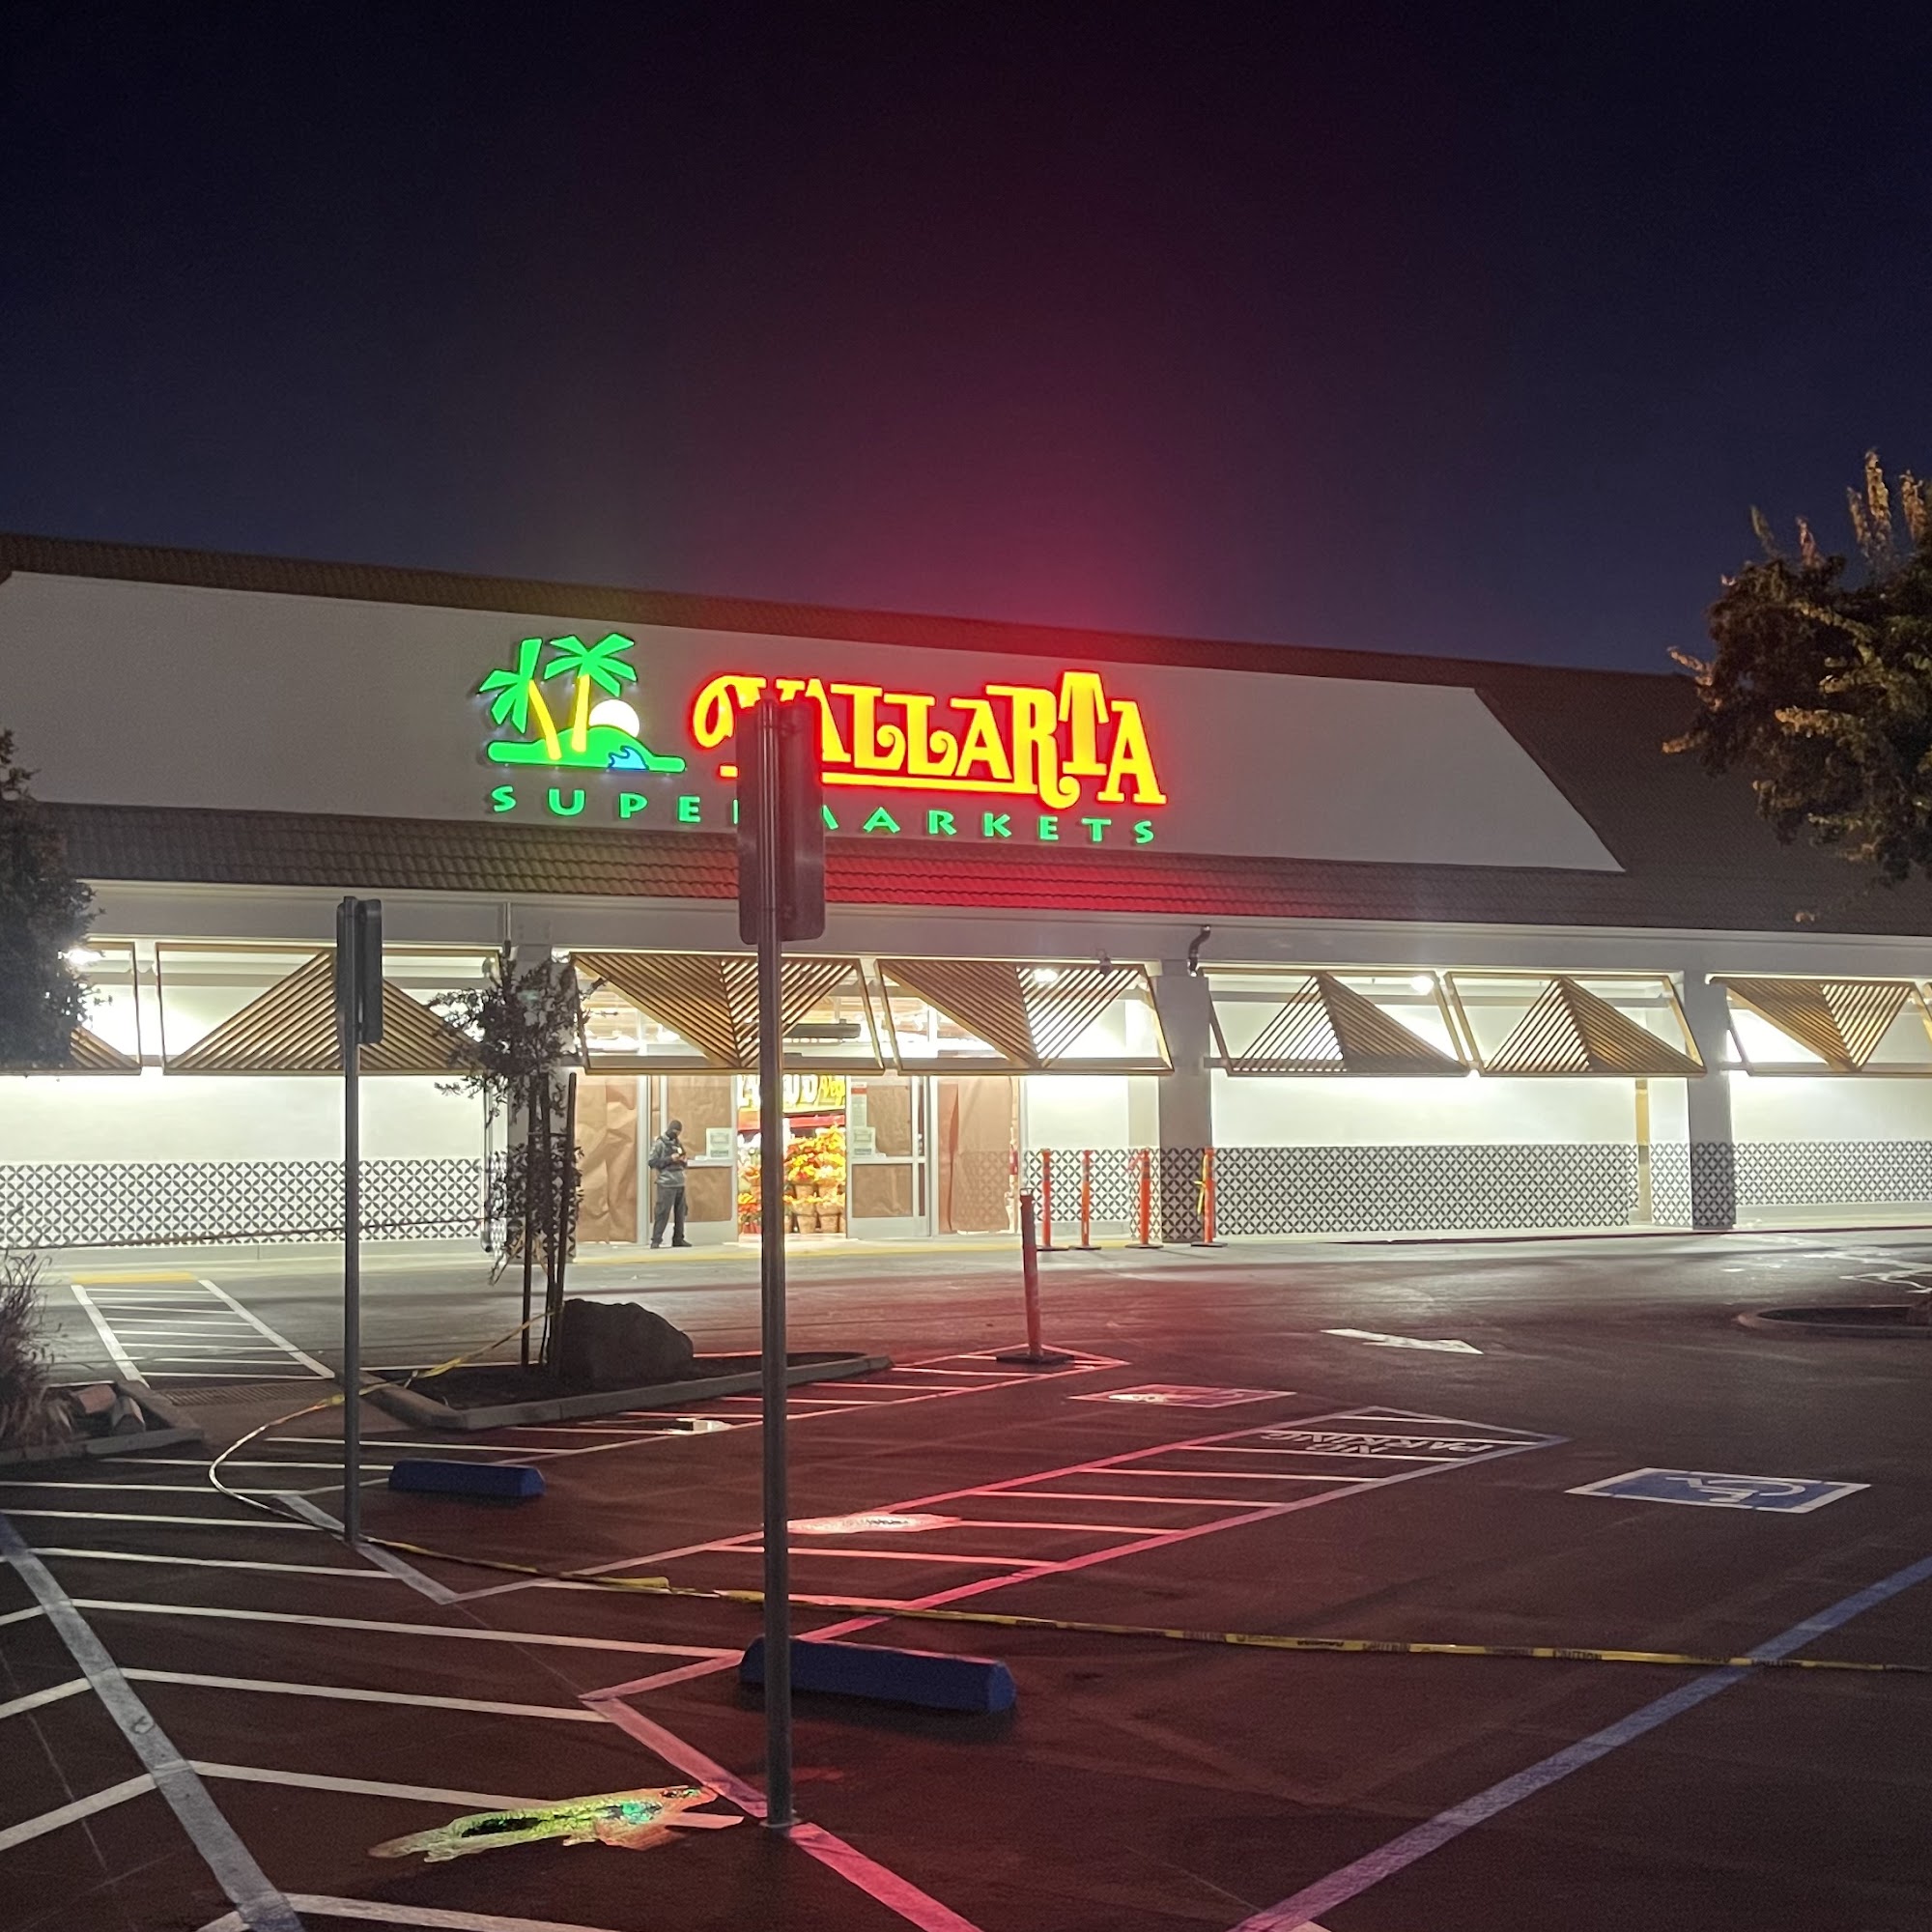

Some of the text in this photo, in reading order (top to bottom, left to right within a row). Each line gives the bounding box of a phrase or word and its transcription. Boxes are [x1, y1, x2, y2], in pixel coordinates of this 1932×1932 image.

[491, 785, 1154, 844] SUPEARKETS
[1261, 1433, 1494, 1453] PARKING
[1306, 1442, 1388, 1455] NO
